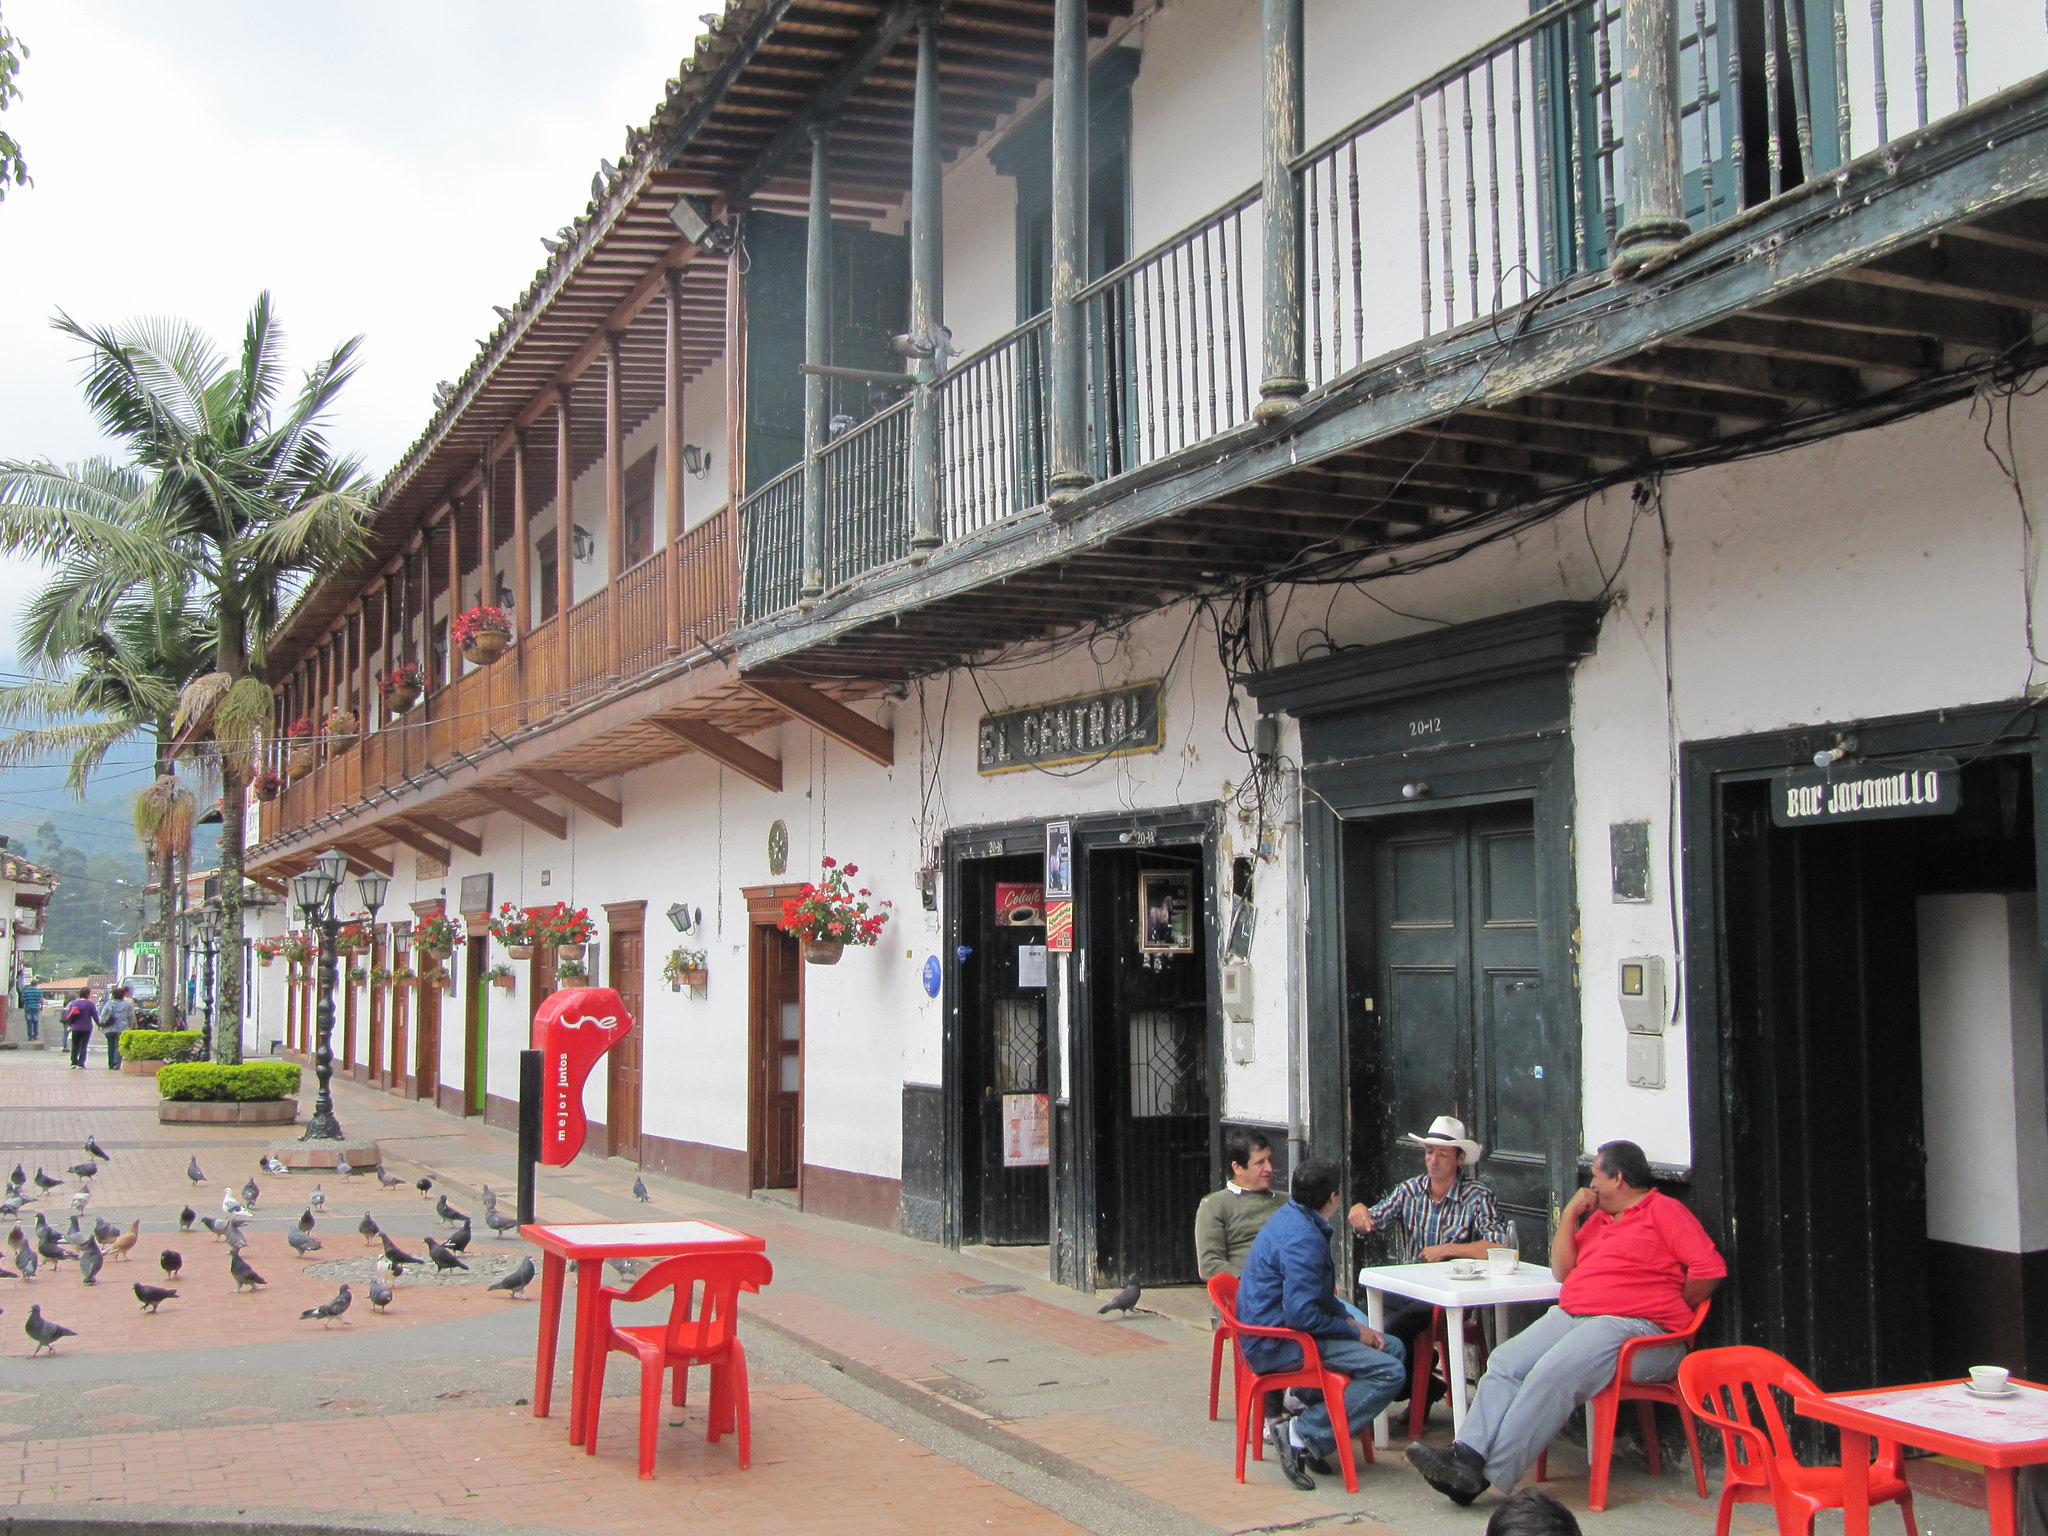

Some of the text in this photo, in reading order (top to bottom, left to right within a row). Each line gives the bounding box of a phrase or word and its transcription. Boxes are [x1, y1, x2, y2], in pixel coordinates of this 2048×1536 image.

[980, 695, 1147, 766] EL CENTRAL
[1409, 717, 1442, 737] 20-12
[560, 1014, 618, 1030] une
[557, 1052, 570, 1142] mejor juntos
